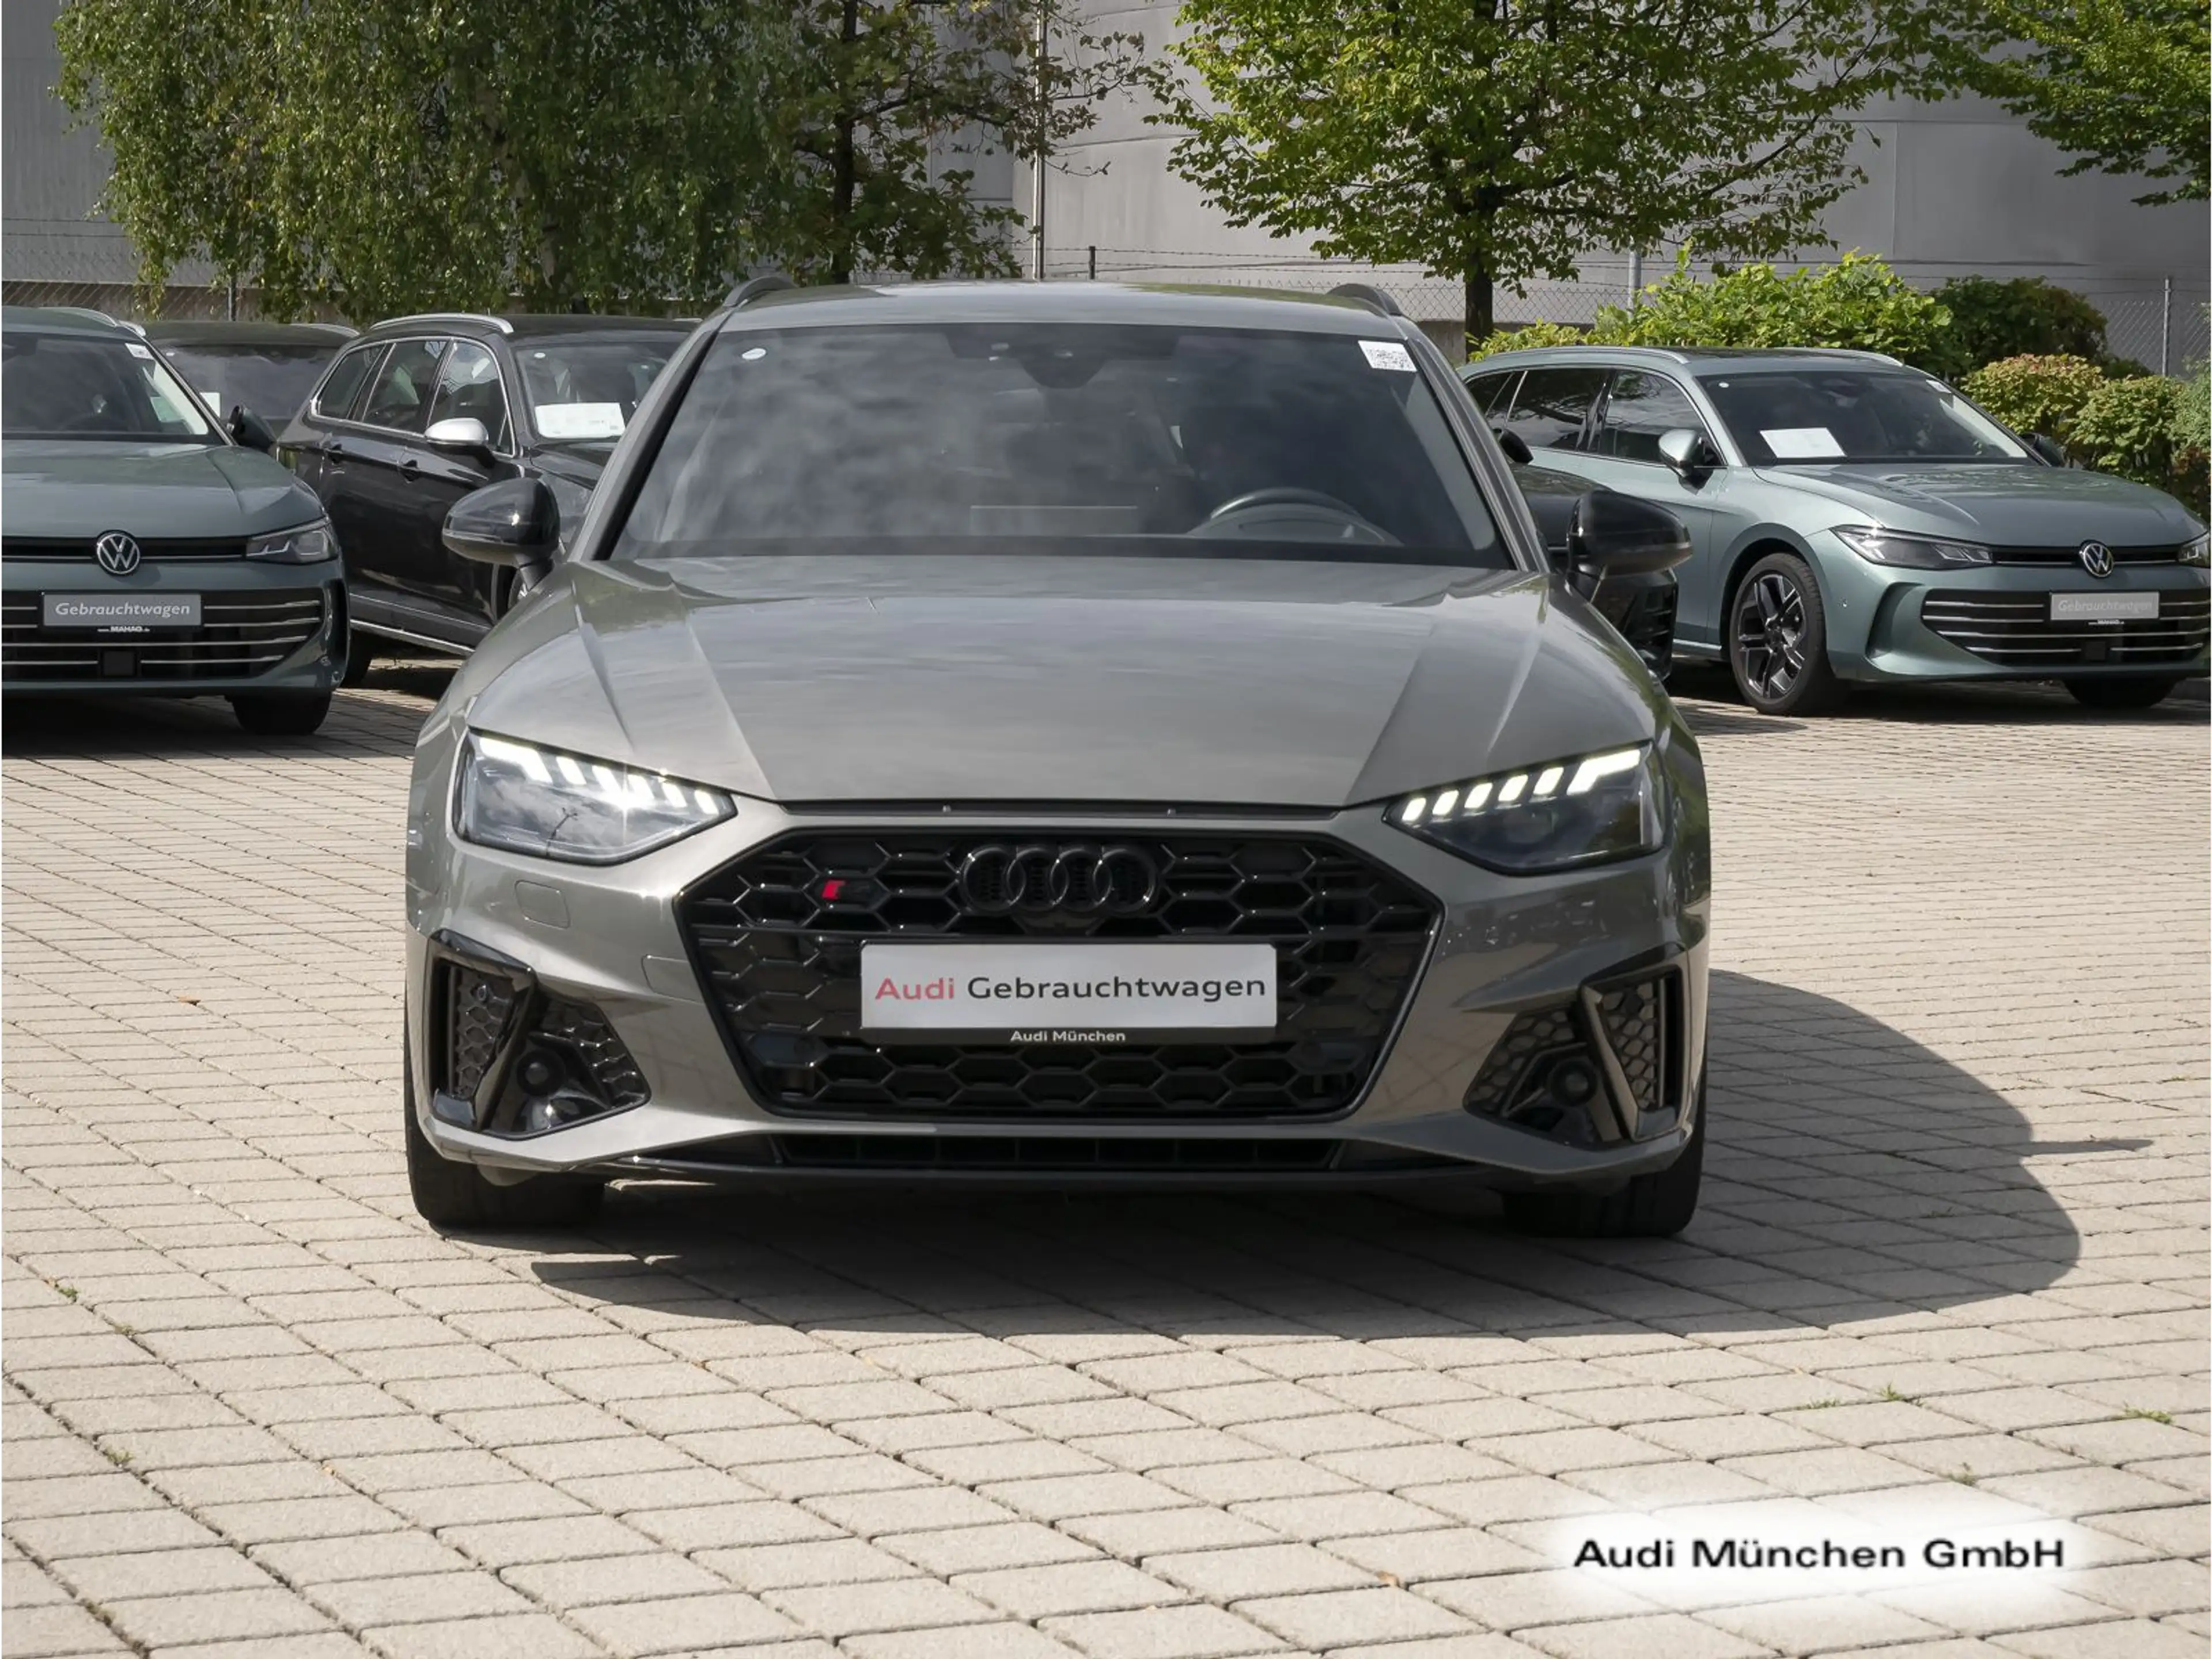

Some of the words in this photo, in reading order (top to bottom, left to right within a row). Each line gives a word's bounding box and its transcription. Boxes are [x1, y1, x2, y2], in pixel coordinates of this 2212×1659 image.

[98, 535, 139, 571] VW
[2084, 544, 2113, 576] VW
[55, 602, 190, 618] Gebrauchtwagen
[875, 978, 955, 1000] Audi
[967, 976, 1265, 1002] Gebrauchtwagen
[1010, 1031, 1047, 1041] Audi
[1052, 1030, 1126, 1041] München
